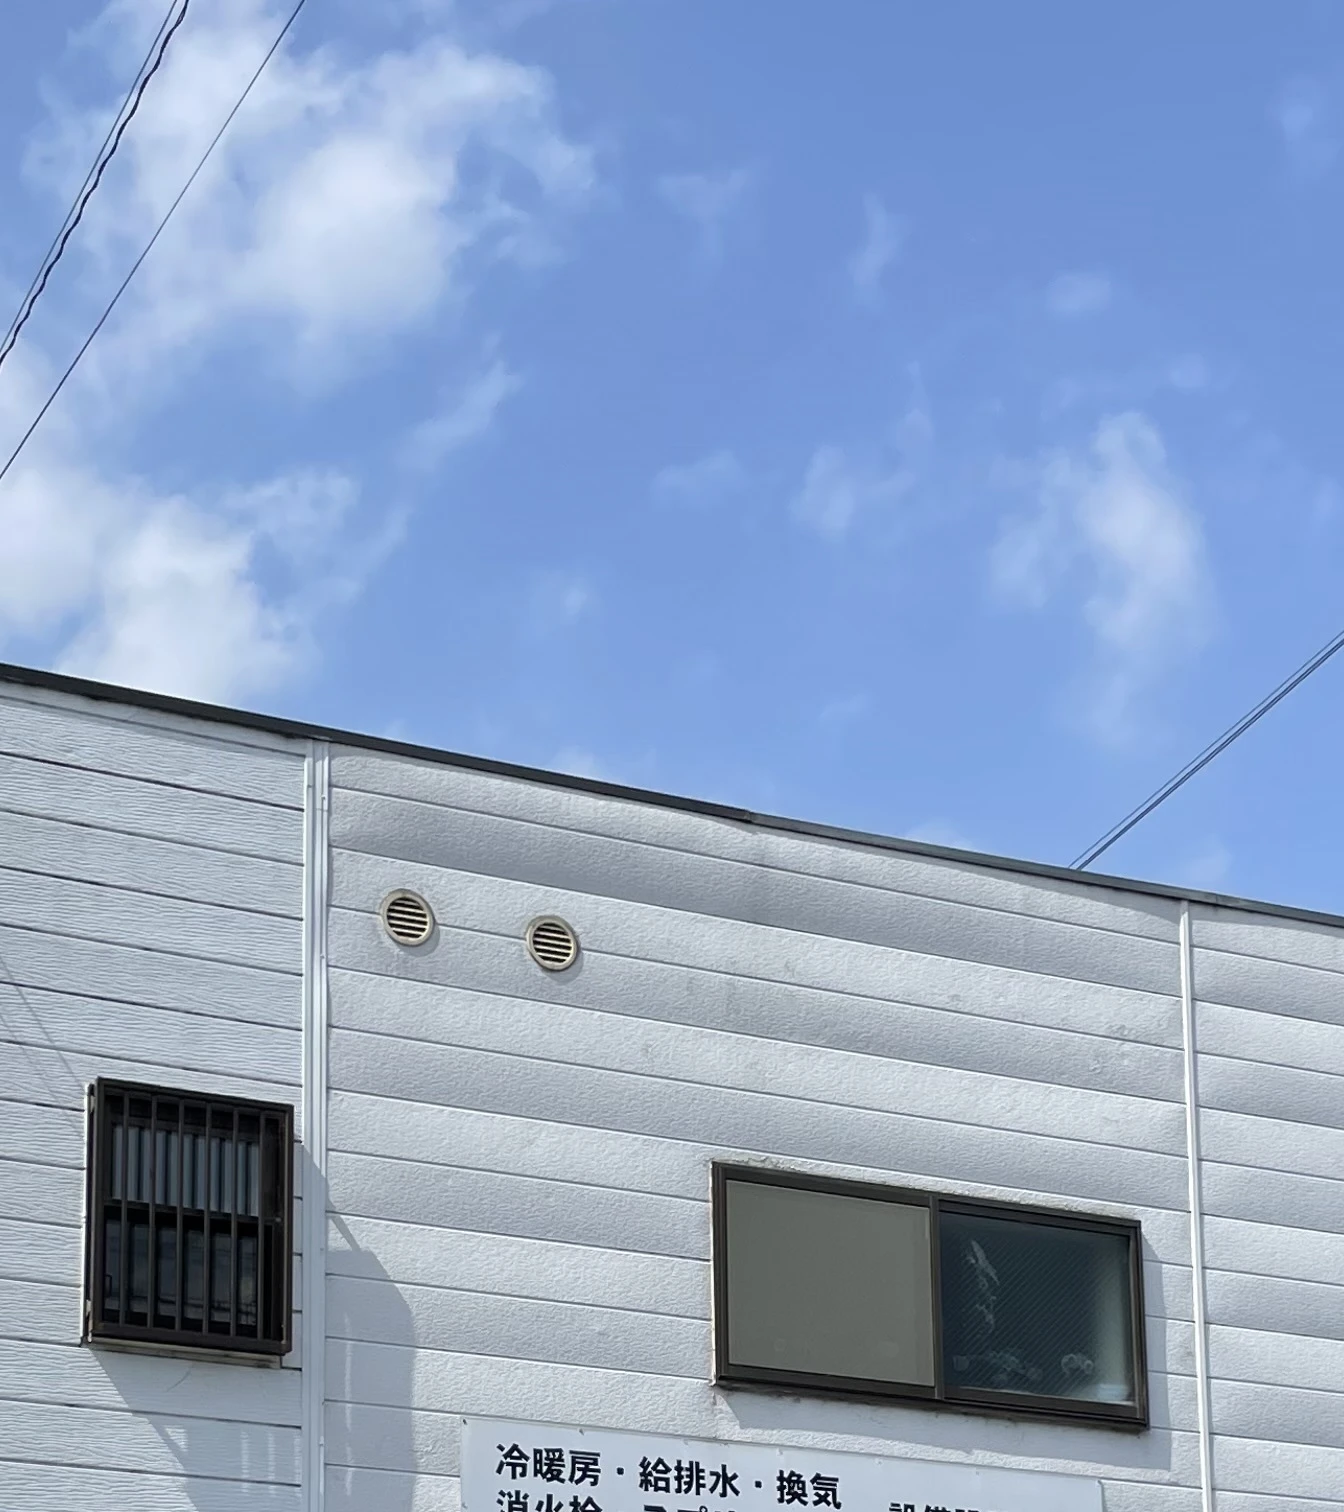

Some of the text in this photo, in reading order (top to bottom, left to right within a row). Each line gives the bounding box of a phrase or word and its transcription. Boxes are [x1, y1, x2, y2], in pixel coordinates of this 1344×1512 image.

[495, 1444, 842, 1510] 冷暖房・給排水・換気
